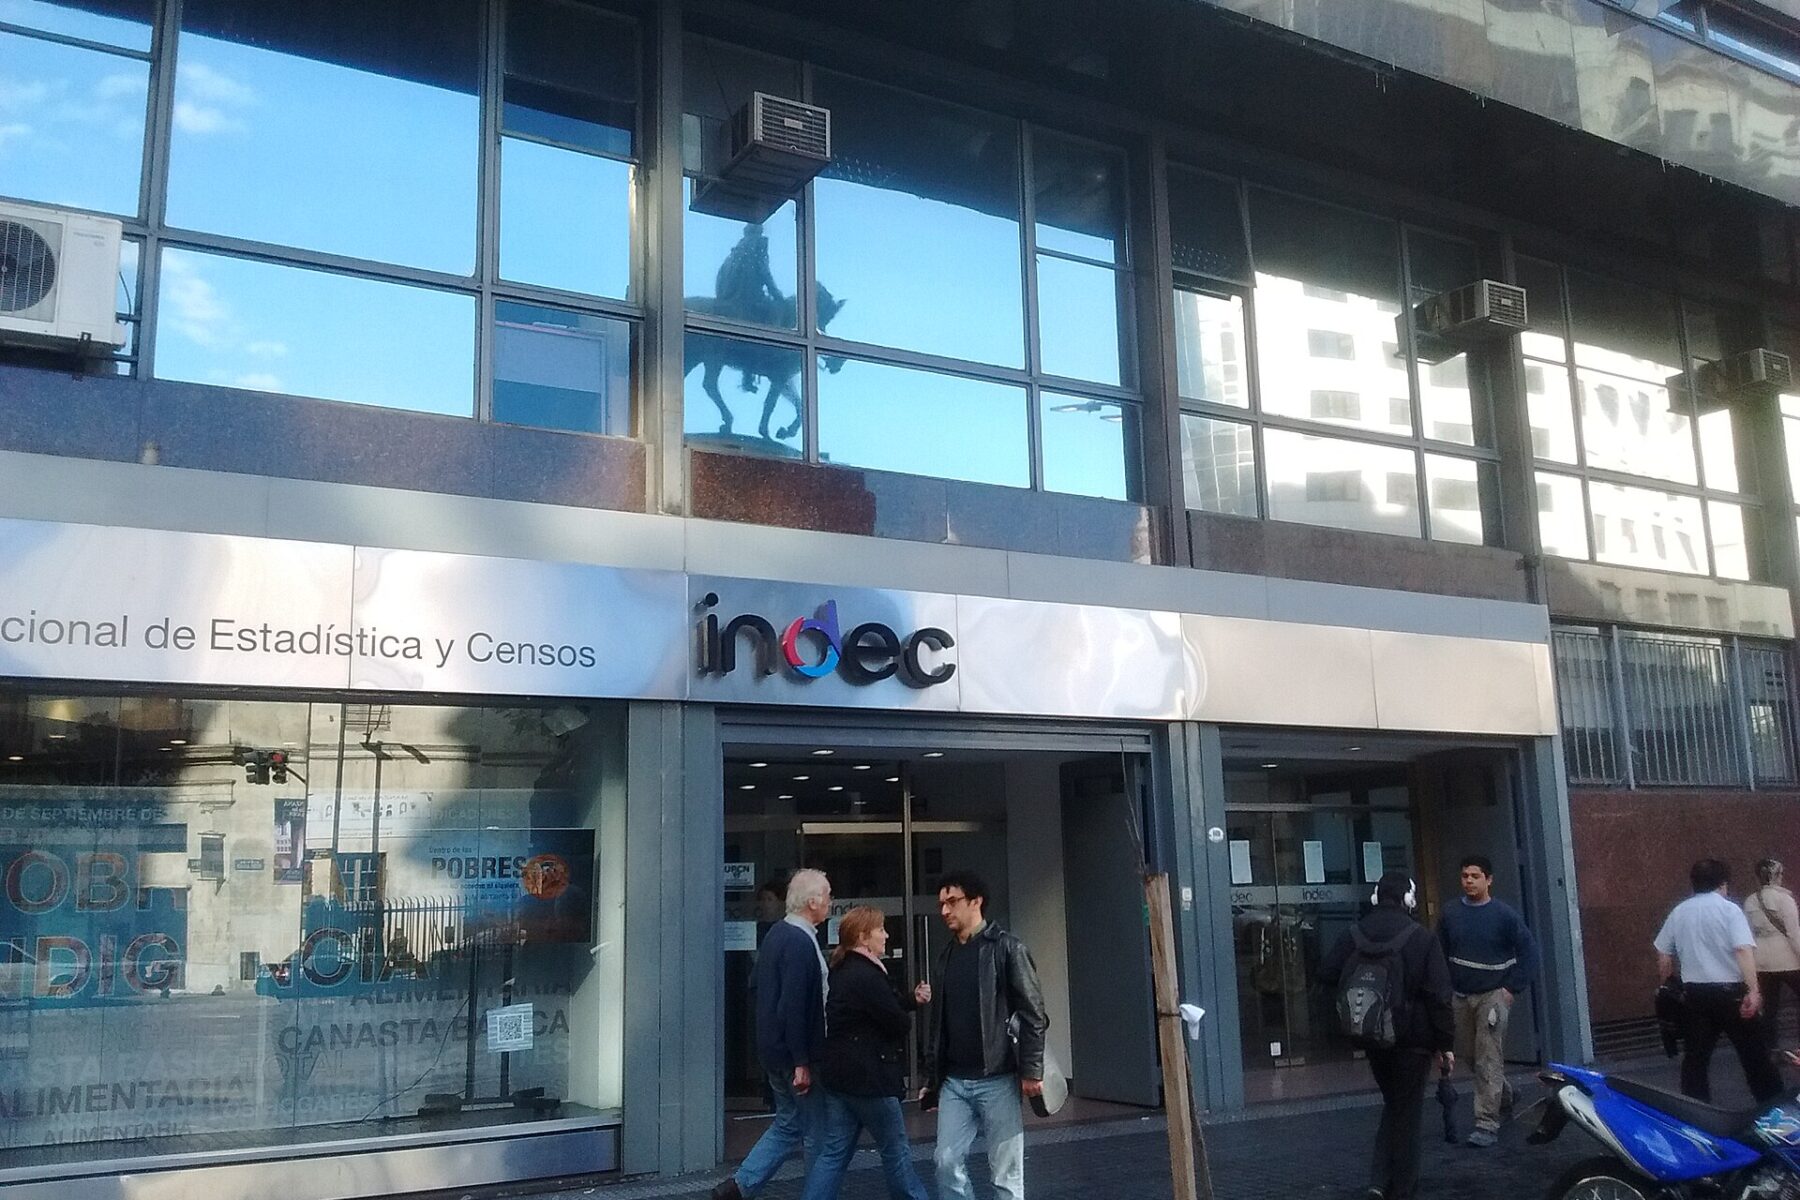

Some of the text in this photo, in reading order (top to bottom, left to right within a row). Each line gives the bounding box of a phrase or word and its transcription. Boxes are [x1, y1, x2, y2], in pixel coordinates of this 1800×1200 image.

[1, 609, 597, 669] cional de Estadística y Censos
[697, 592, 957, 687] indec
[431, 856, 527, 880] POBRES
[277, 1017, 441, 1054] CANASTA
